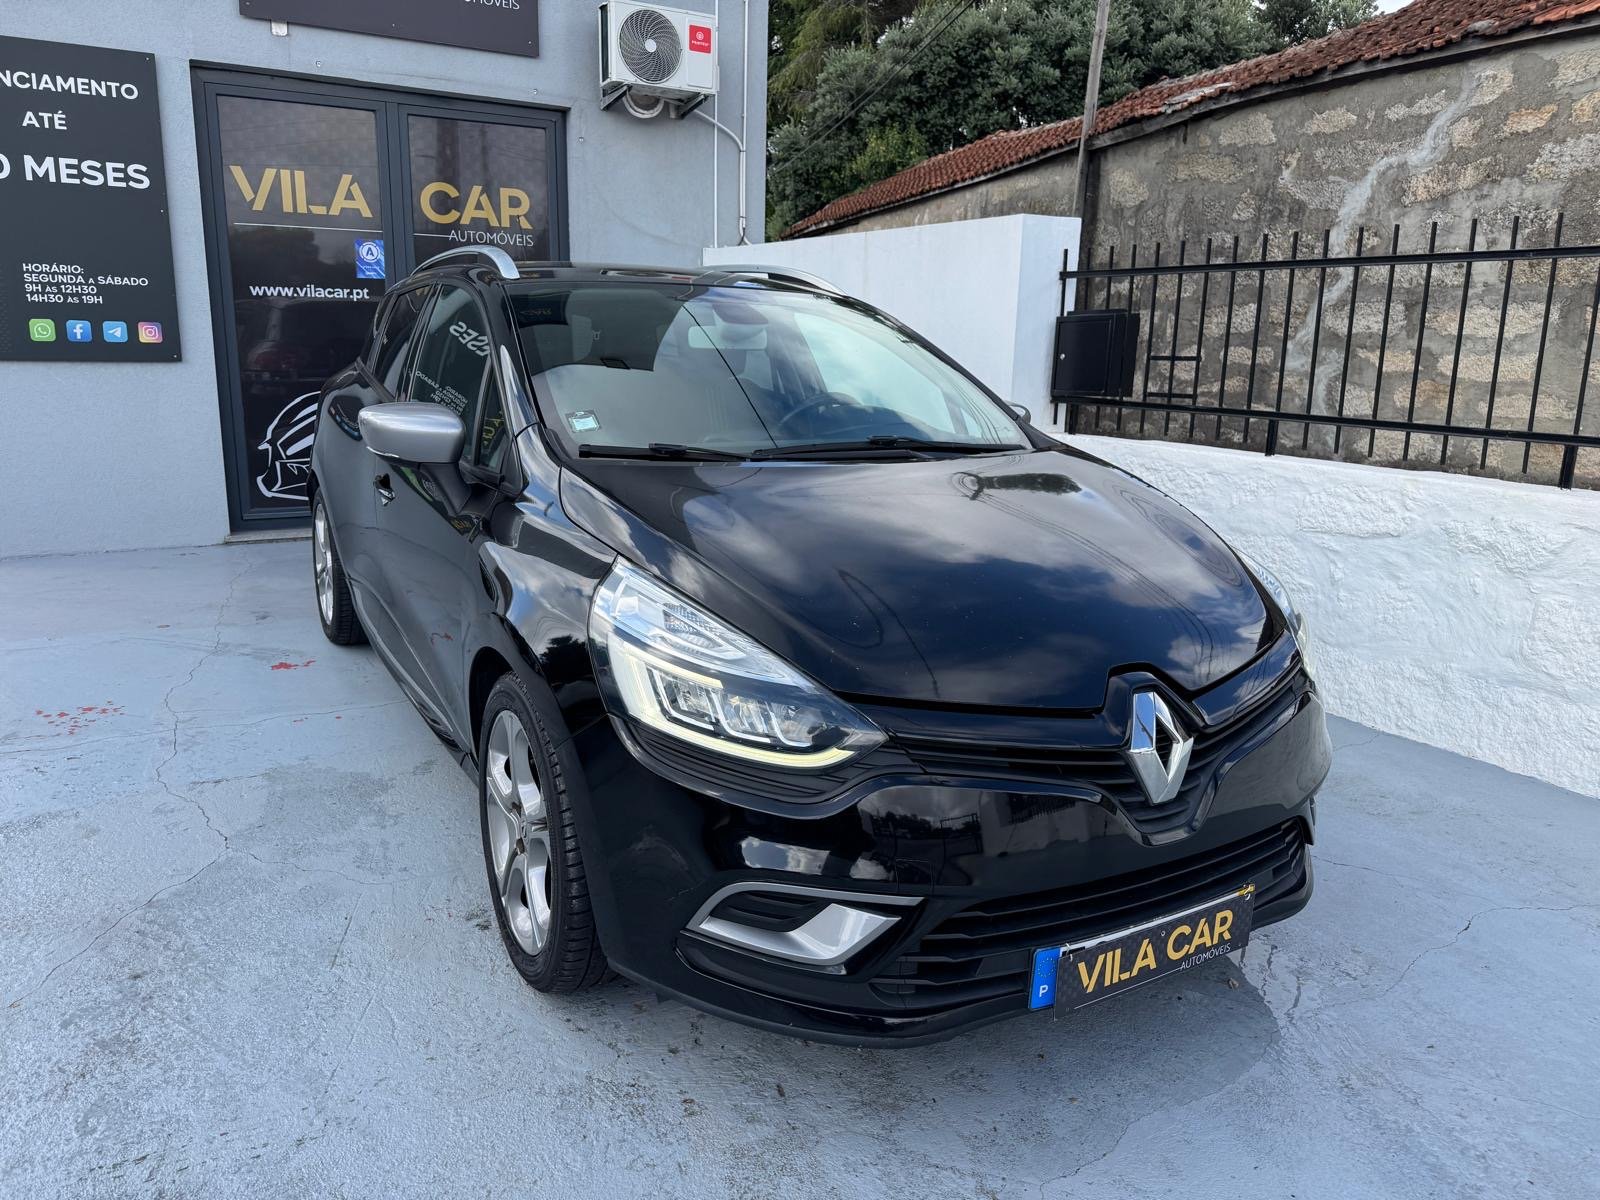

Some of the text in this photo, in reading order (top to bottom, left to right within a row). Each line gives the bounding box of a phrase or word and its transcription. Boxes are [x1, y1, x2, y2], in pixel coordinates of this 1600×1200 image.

[22, 110, 68, 130] ATÉ
[23, 154, 151, 190] MESES
[229, 165, 534, 230] VILA CAR
[448, 229, 534, 248] AUTOMÓVEIS
[22, 262, 84, 274] HORÁRIO:
[23, 273, 85, 284] SEGUNDA
[97, 274, 149, 286] SÁBADO
[24, 283, 97, 294] 9H ÀS 12H30
[25, 293, 64, 303] 14H30
[81, 295, 103, 304] 19H
[249, 283, 370, 301] www.vilacar.pt
[1077, 909, 1233, 993] VILA CAR
[1180, 942, 1231, 971] AUTOMÓVEIS
[1039, 985, 1049, 998] P
